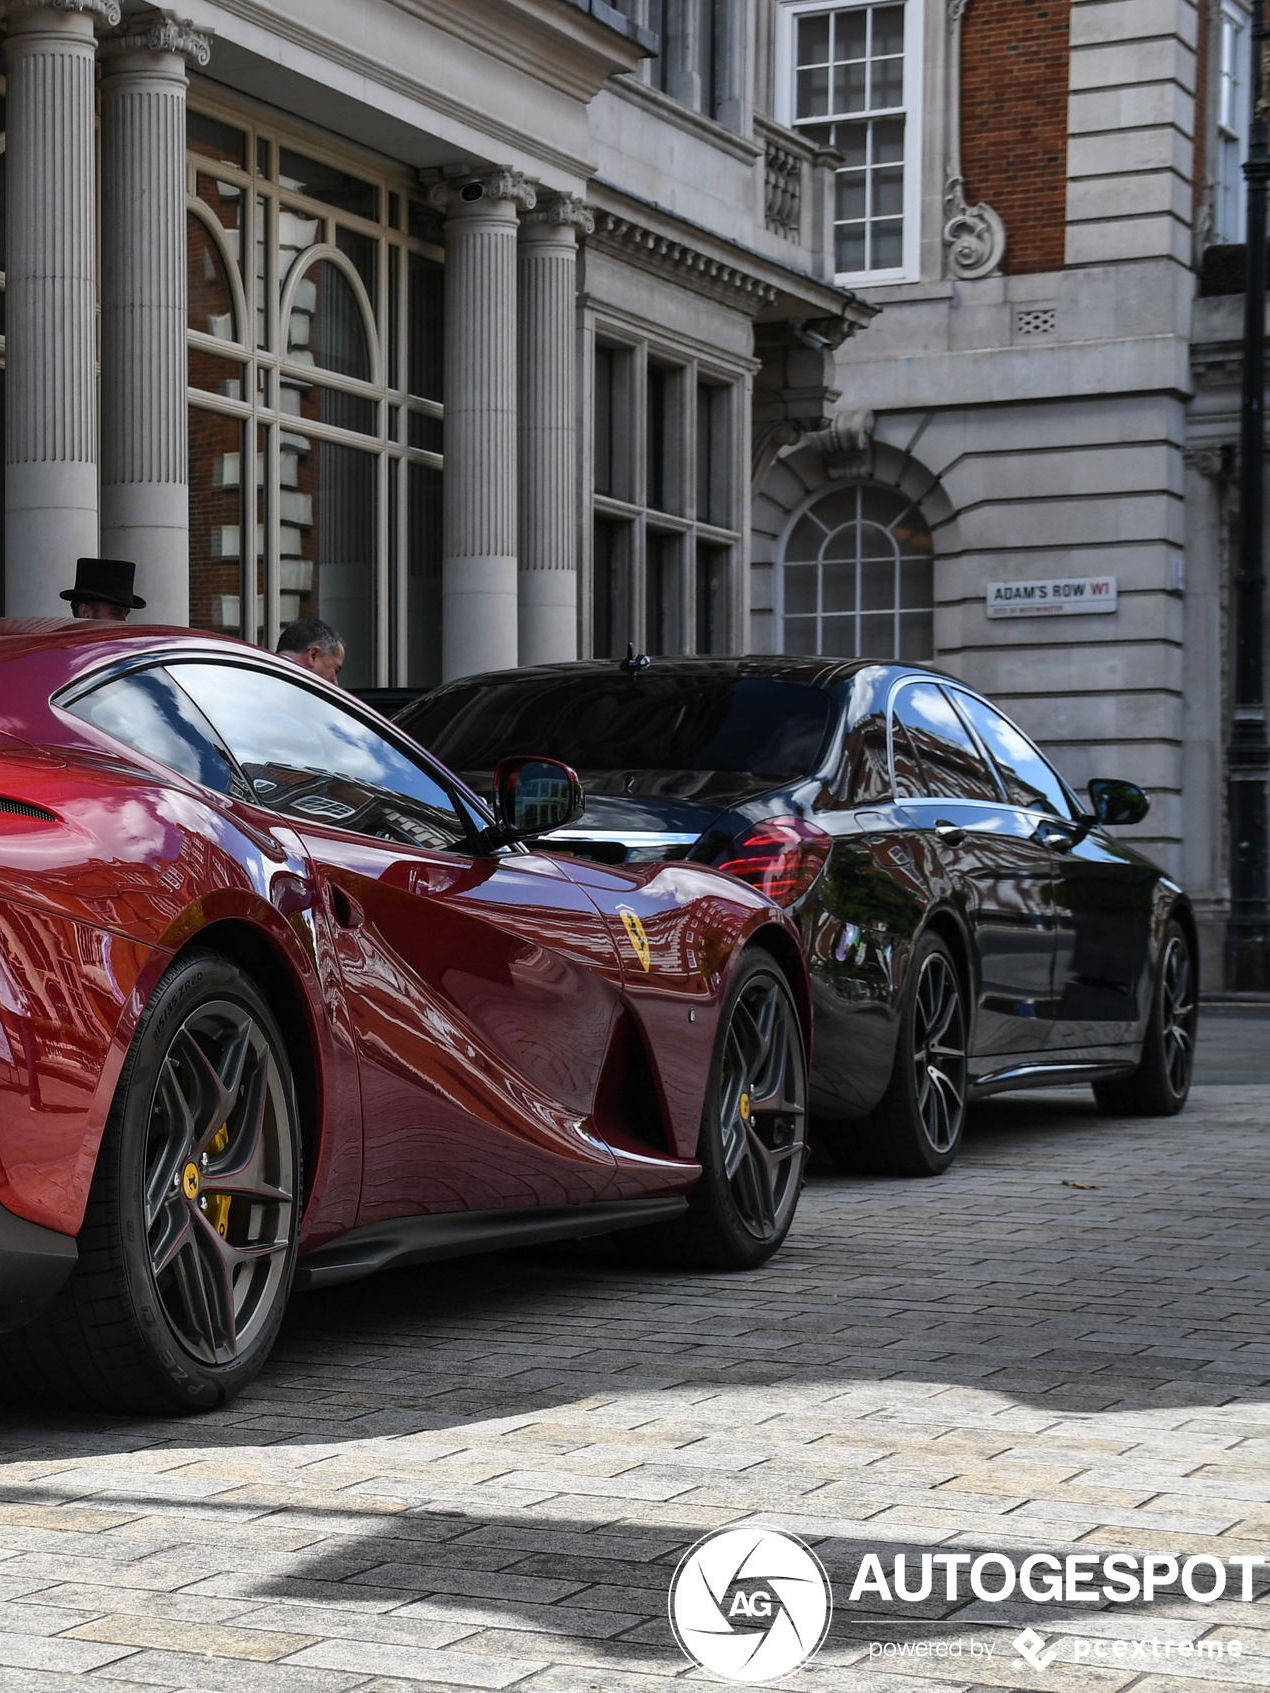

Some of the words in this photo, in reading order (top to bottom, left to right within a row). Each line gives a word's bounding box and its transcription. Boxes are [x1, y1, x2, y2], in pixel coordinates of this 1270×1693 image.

[994, 586, 1047, 601] ADAM'S
[1053, 584, 1086, 598] ROW
[1090, 582, 1110, 596] W1
[152, 995, 178, 1042] 315/35
[178, 971, 203, 997] ZR20
